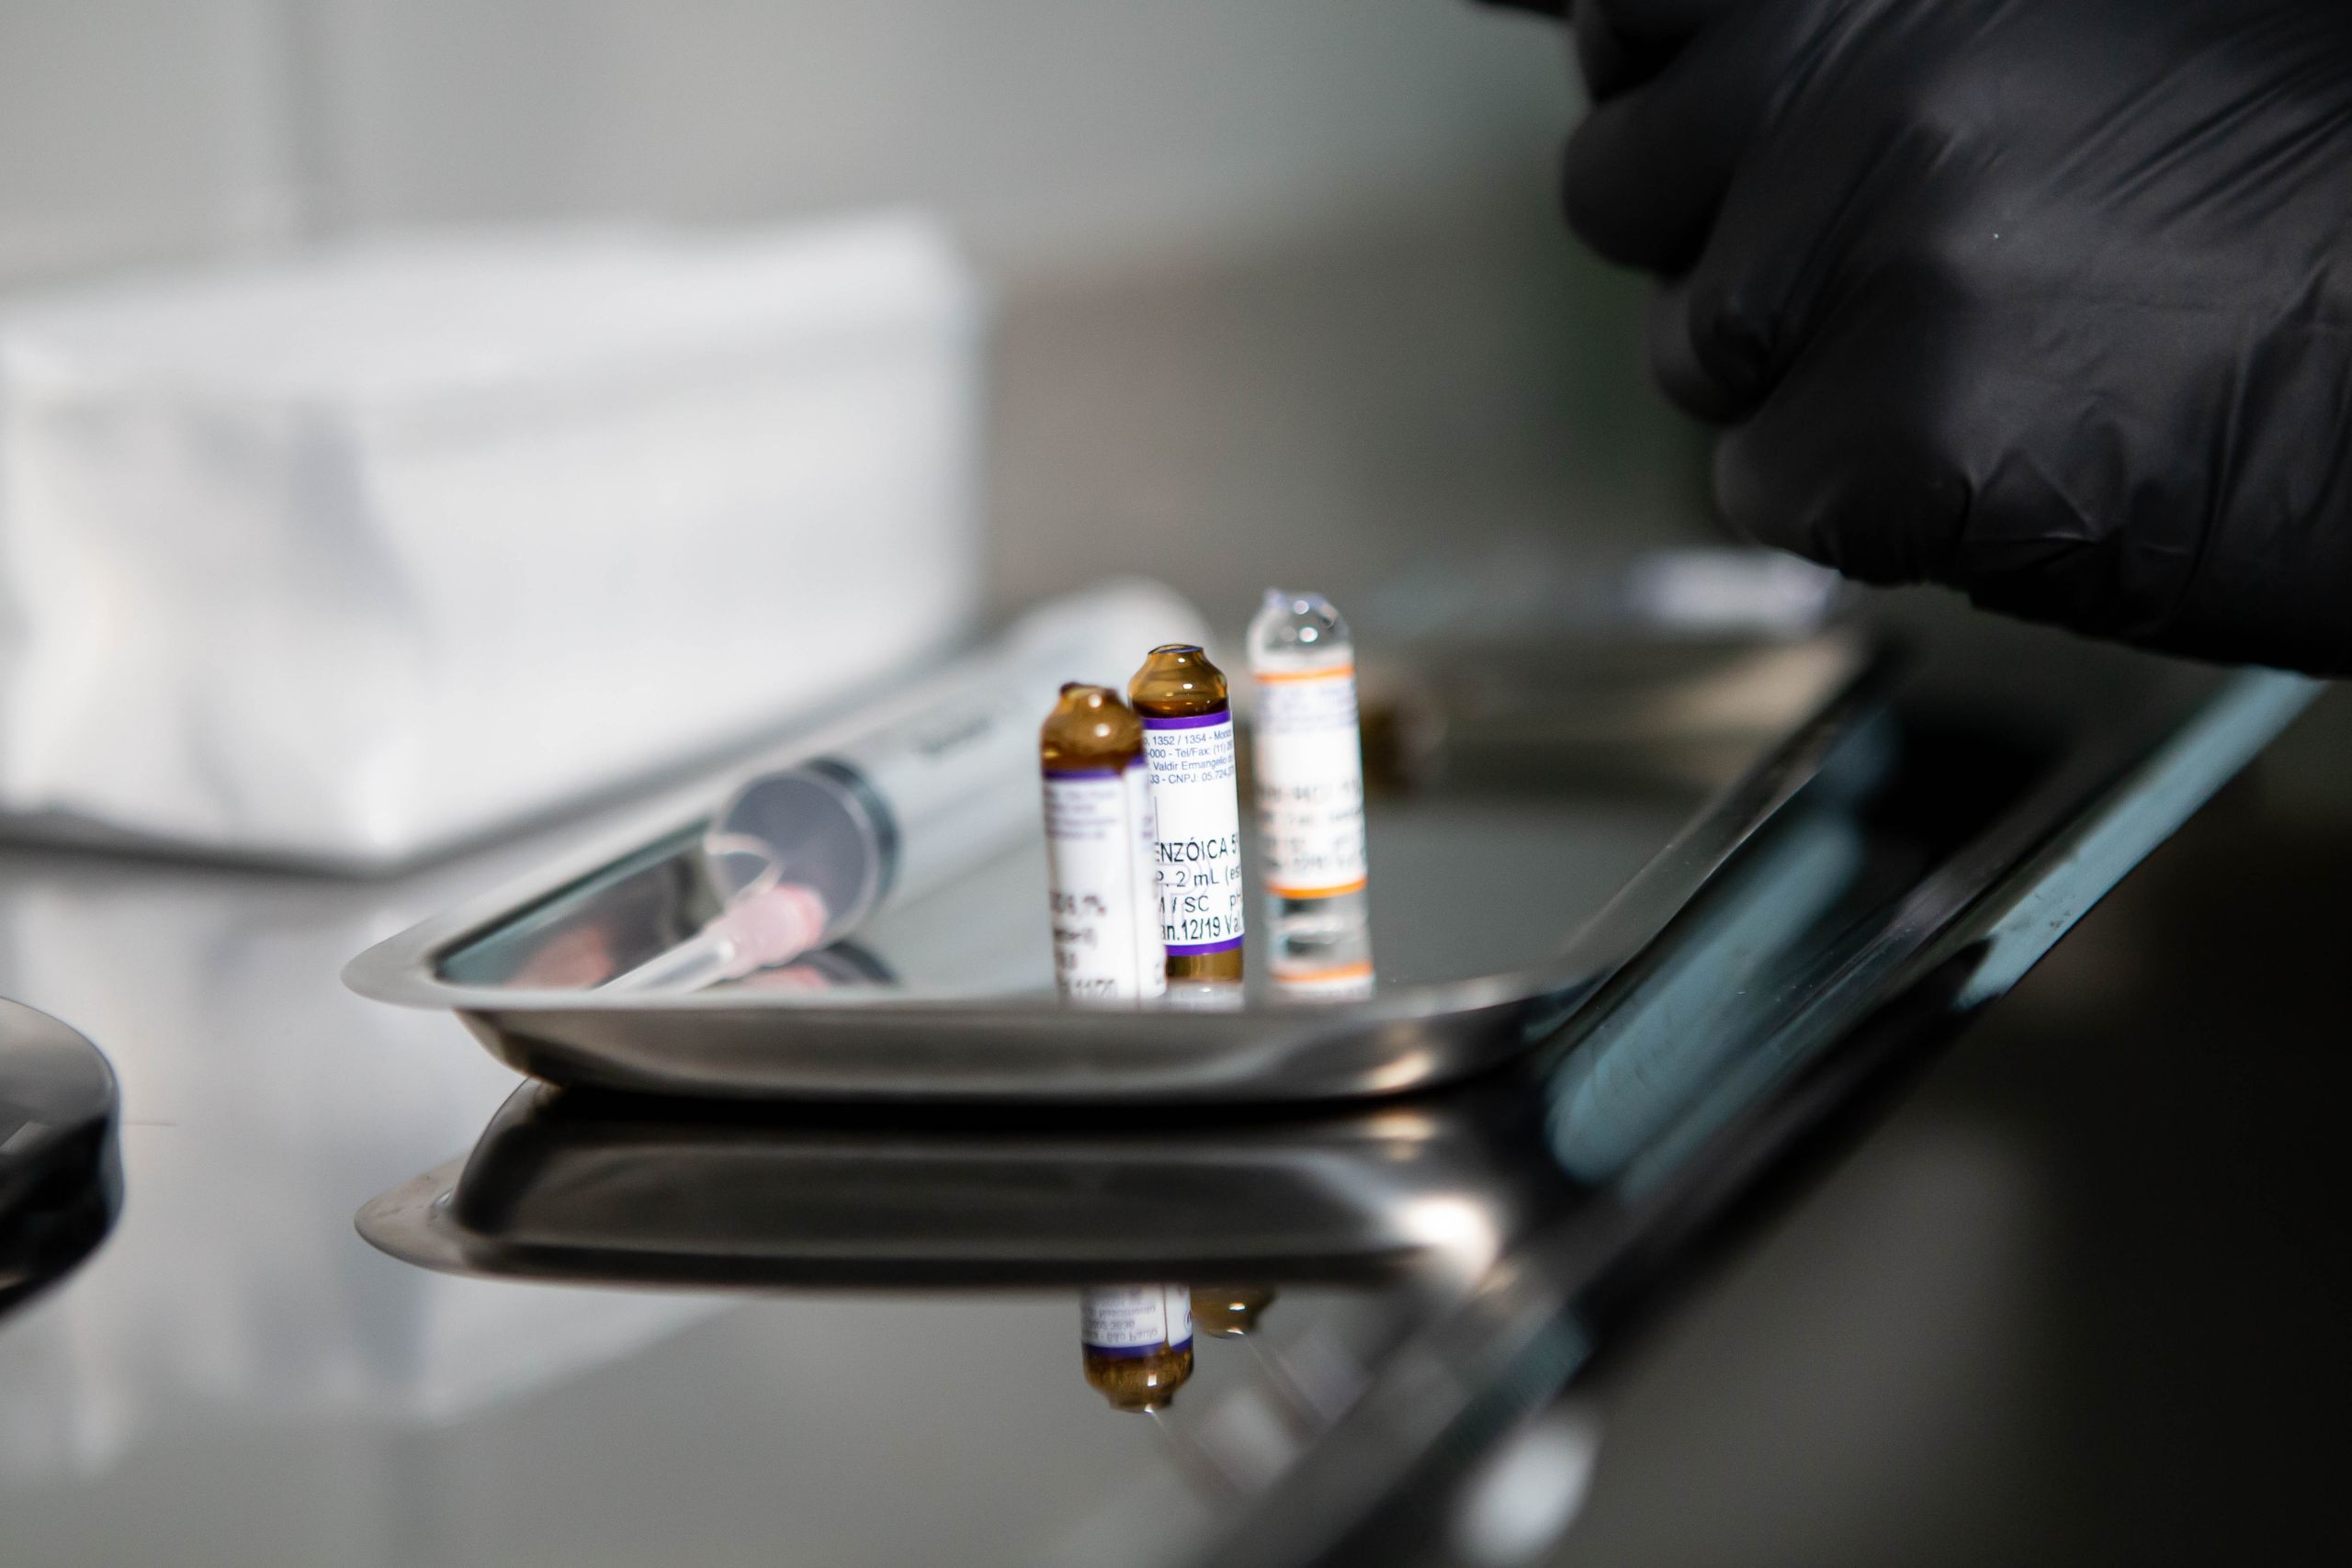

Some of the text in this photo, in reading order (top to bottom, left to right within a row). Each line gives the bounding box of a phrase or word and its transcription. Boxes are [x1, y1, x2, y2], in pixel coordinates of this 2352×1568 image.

[1153, 736, 1175, 746] 1352
[1177, 734, 1182, 746] /
[1184, 733, 1206, 744] 1354
[1153, 761, 1178, 772] Valdir
[1176, 870, 1186, 887] 2
[1194, 867, 1220, 886] mL
[1172, 897, 1177, 913] /
[1184, 895, 1210, 913] SC
